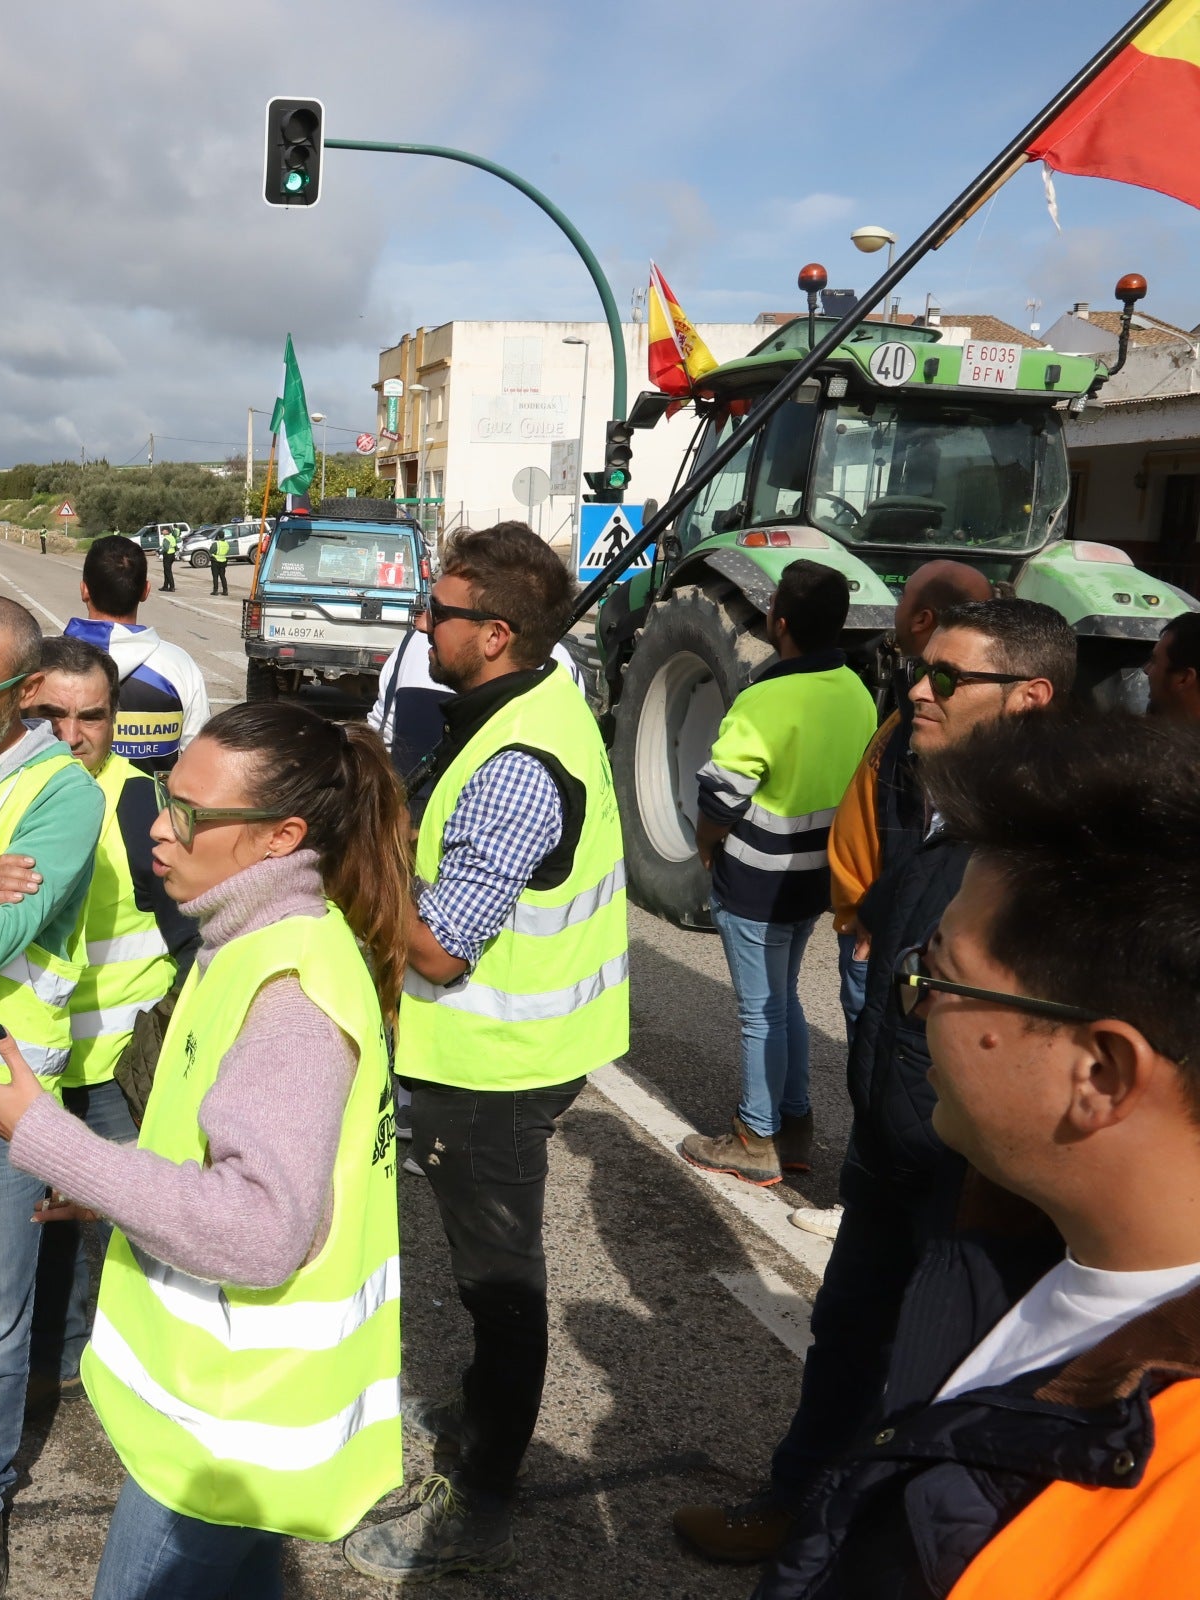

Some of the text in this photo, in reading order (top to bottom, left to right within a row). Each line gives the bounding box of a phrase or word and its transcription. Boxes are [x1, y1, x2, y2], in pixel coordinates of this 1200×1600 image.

[966, 345, 1015, 363] E 6035
[877, 346, 905, 380] 40
[972, 366, 1005, 383] BFN
[519, 402, 557, 410] BODEGAS
[478, 417, 565, 438] CRUZ CONDE
[274, 628, 325, 638] MA 4897 AK
[117, 723, 179, 736] HOLLAND
